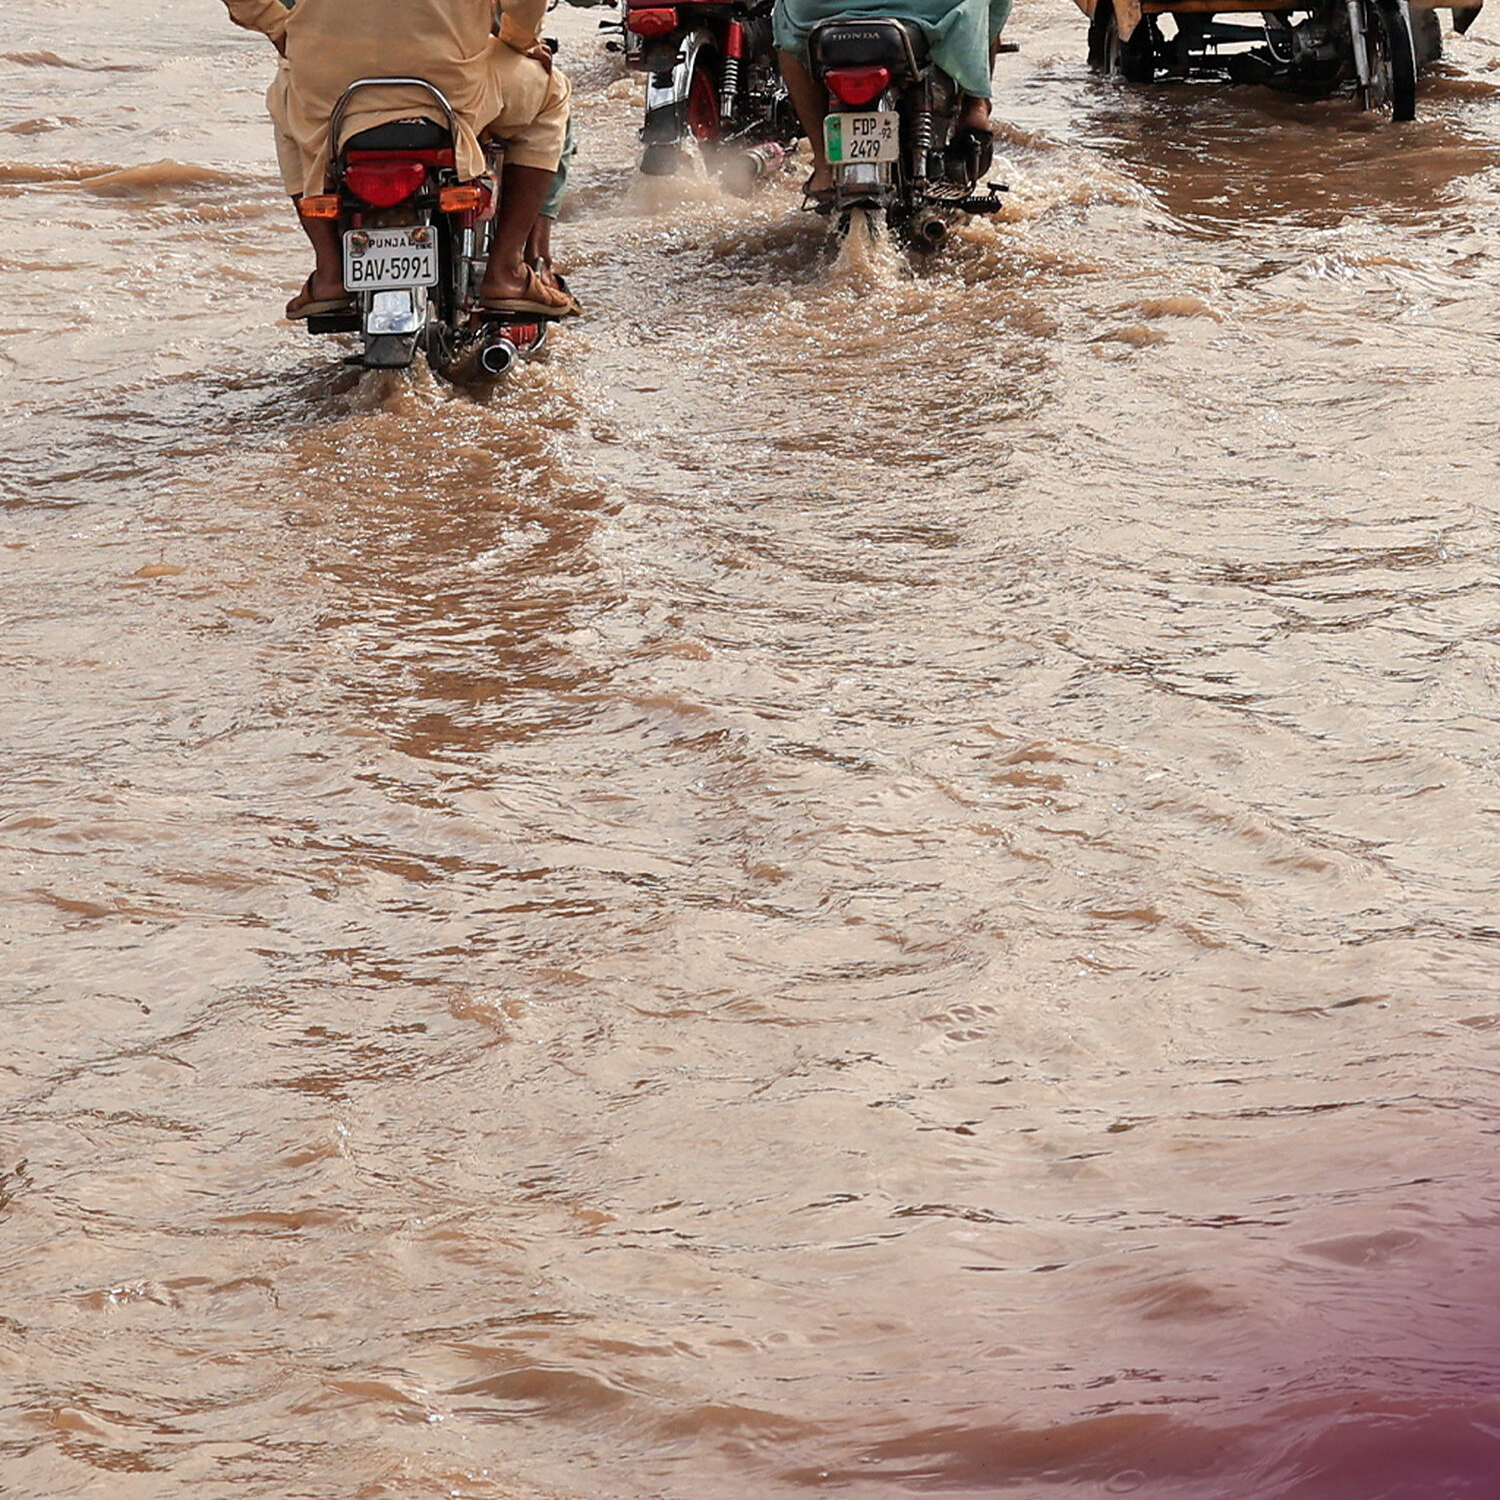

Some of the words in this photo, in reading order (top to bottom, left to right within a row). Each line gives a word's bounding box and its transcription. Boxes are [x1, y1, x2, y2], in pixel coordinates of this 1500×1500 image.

[832, 32, 881, 40] HONDA
[853, 117, 877, 136] FDP
[850, 140, 880, 158] 2479
[352, 256, 432, 282] BAV-5991
